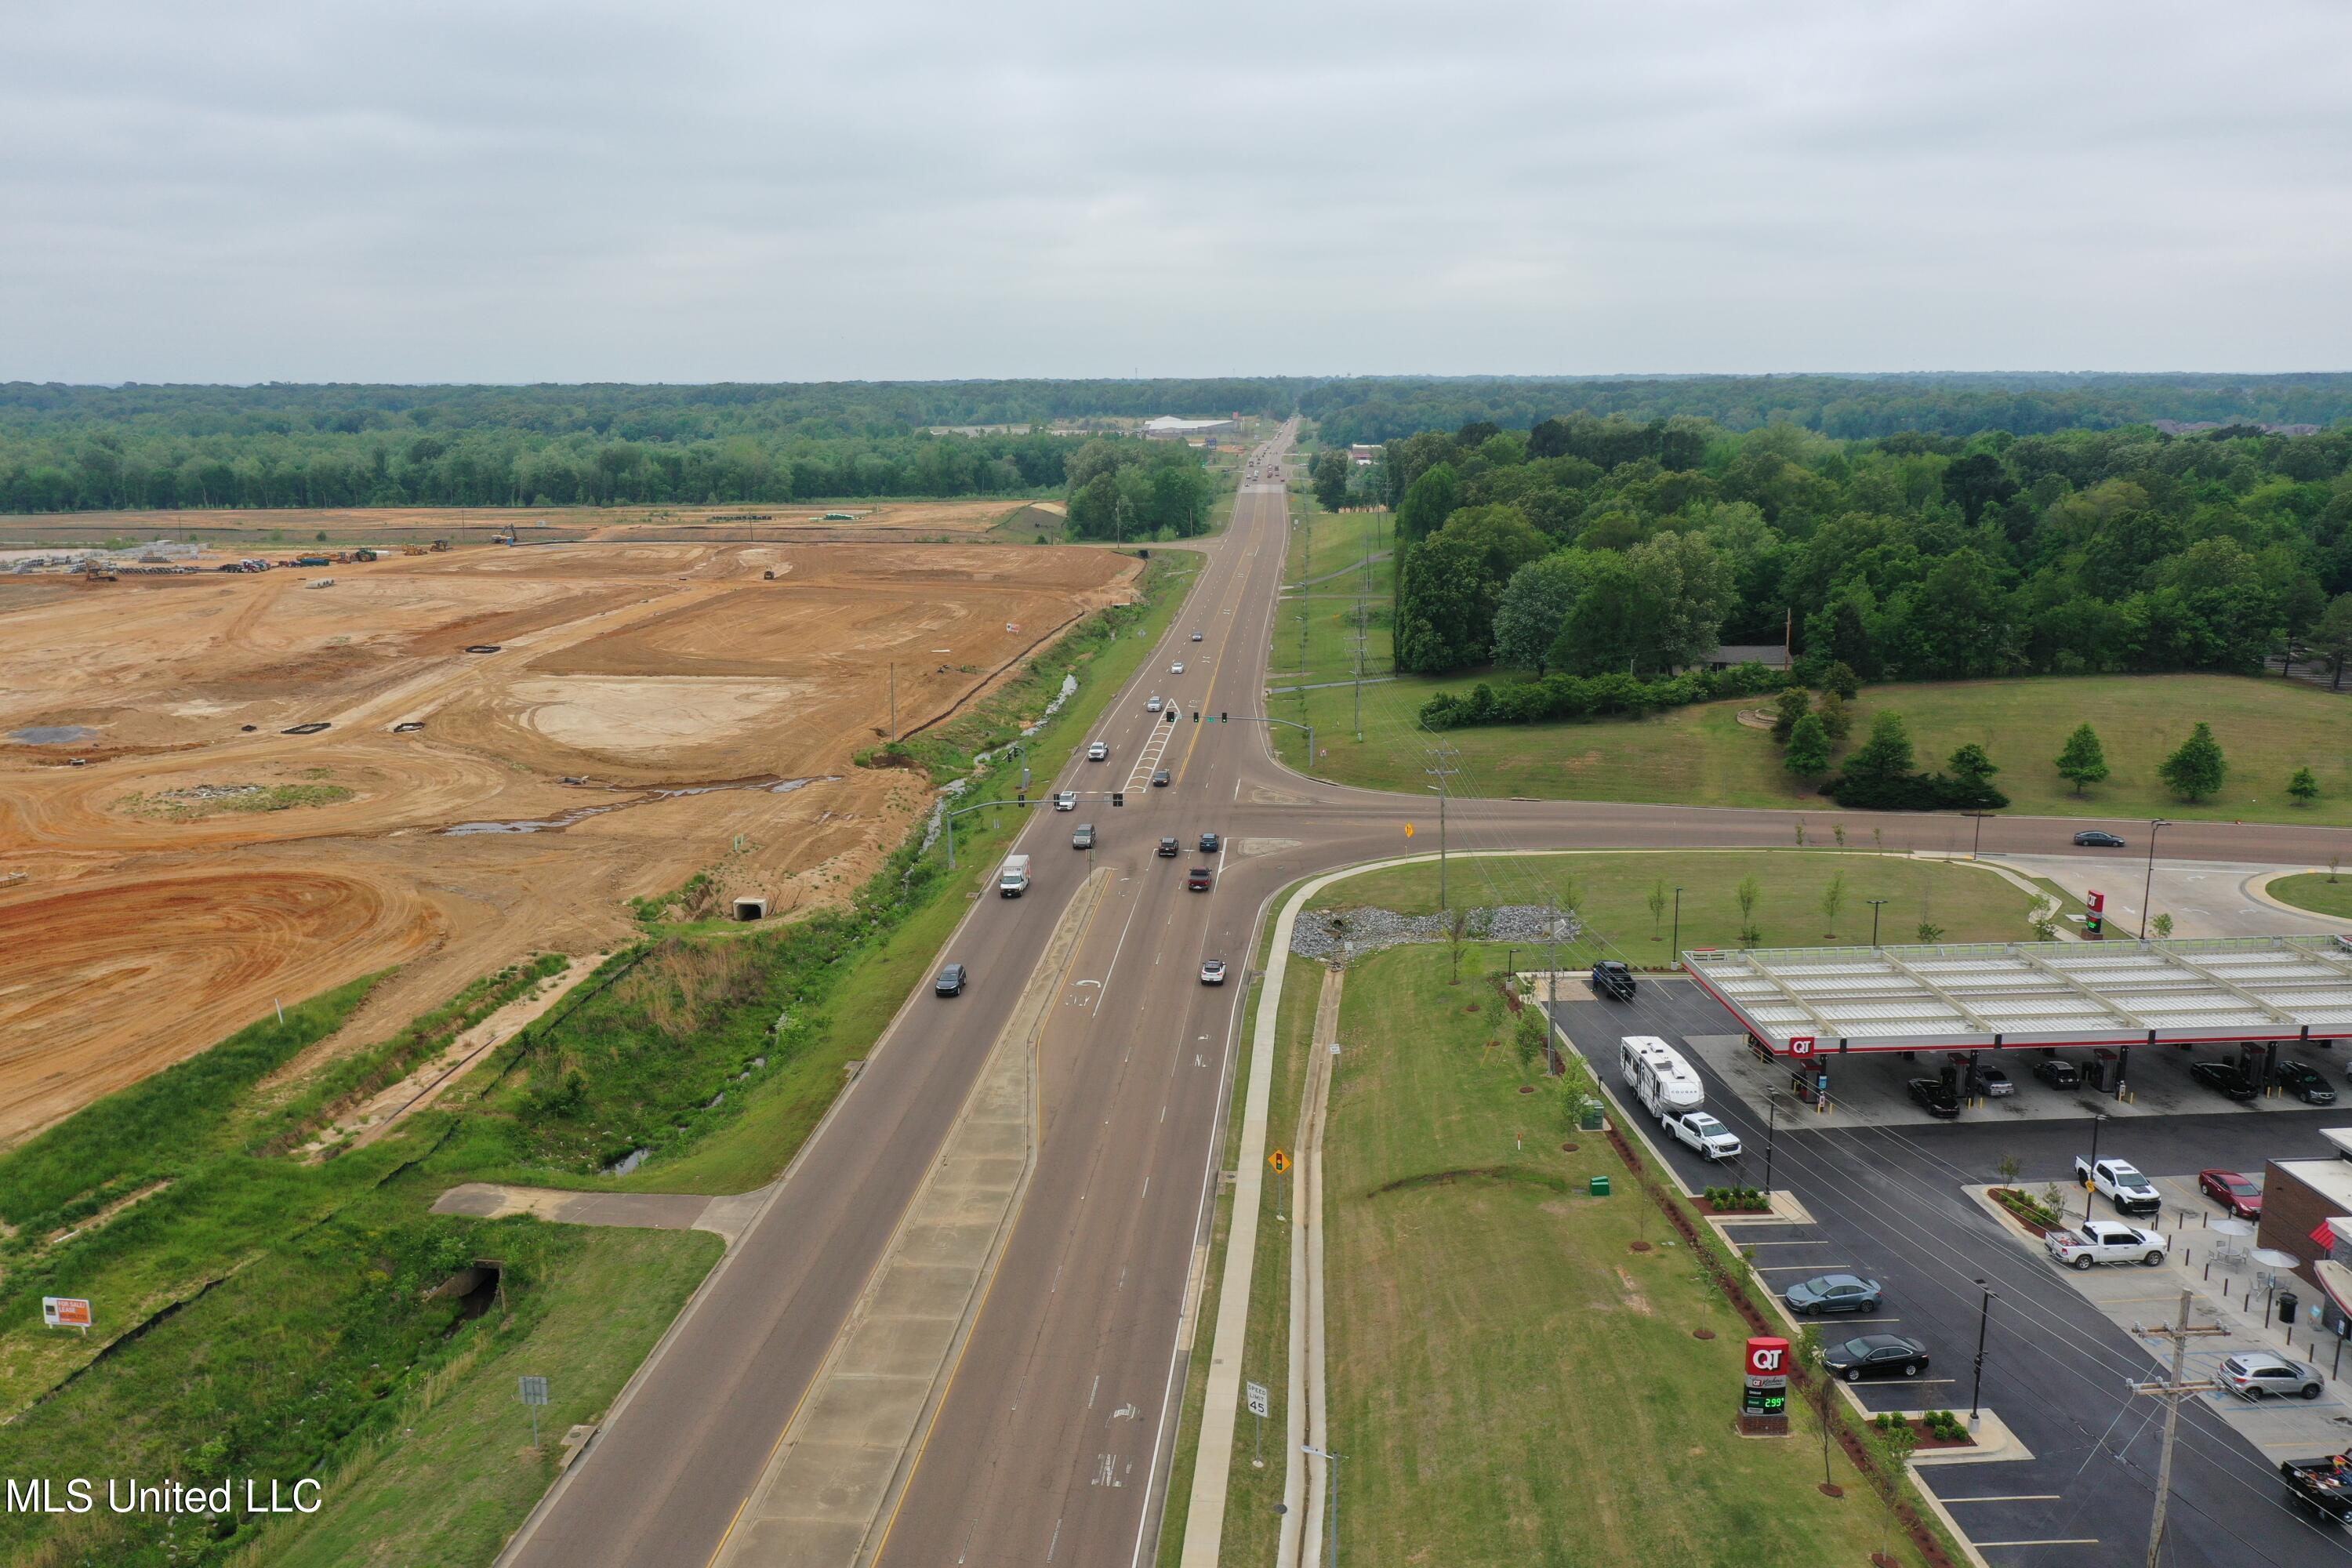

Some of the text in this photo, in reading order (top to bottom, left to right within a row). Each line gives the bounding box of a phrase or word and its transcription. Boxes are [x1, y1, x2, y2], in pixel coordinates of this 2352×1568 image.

[1793, 1040, 1811, 1054] QT
[1753, 1349, 1782, 1370] QT
[1248, 1385, 1266, 1396] SPEED
[1250, 1392, 1264, 1401] LIMIT
[1250, 1401, 1264, 1413] 45
